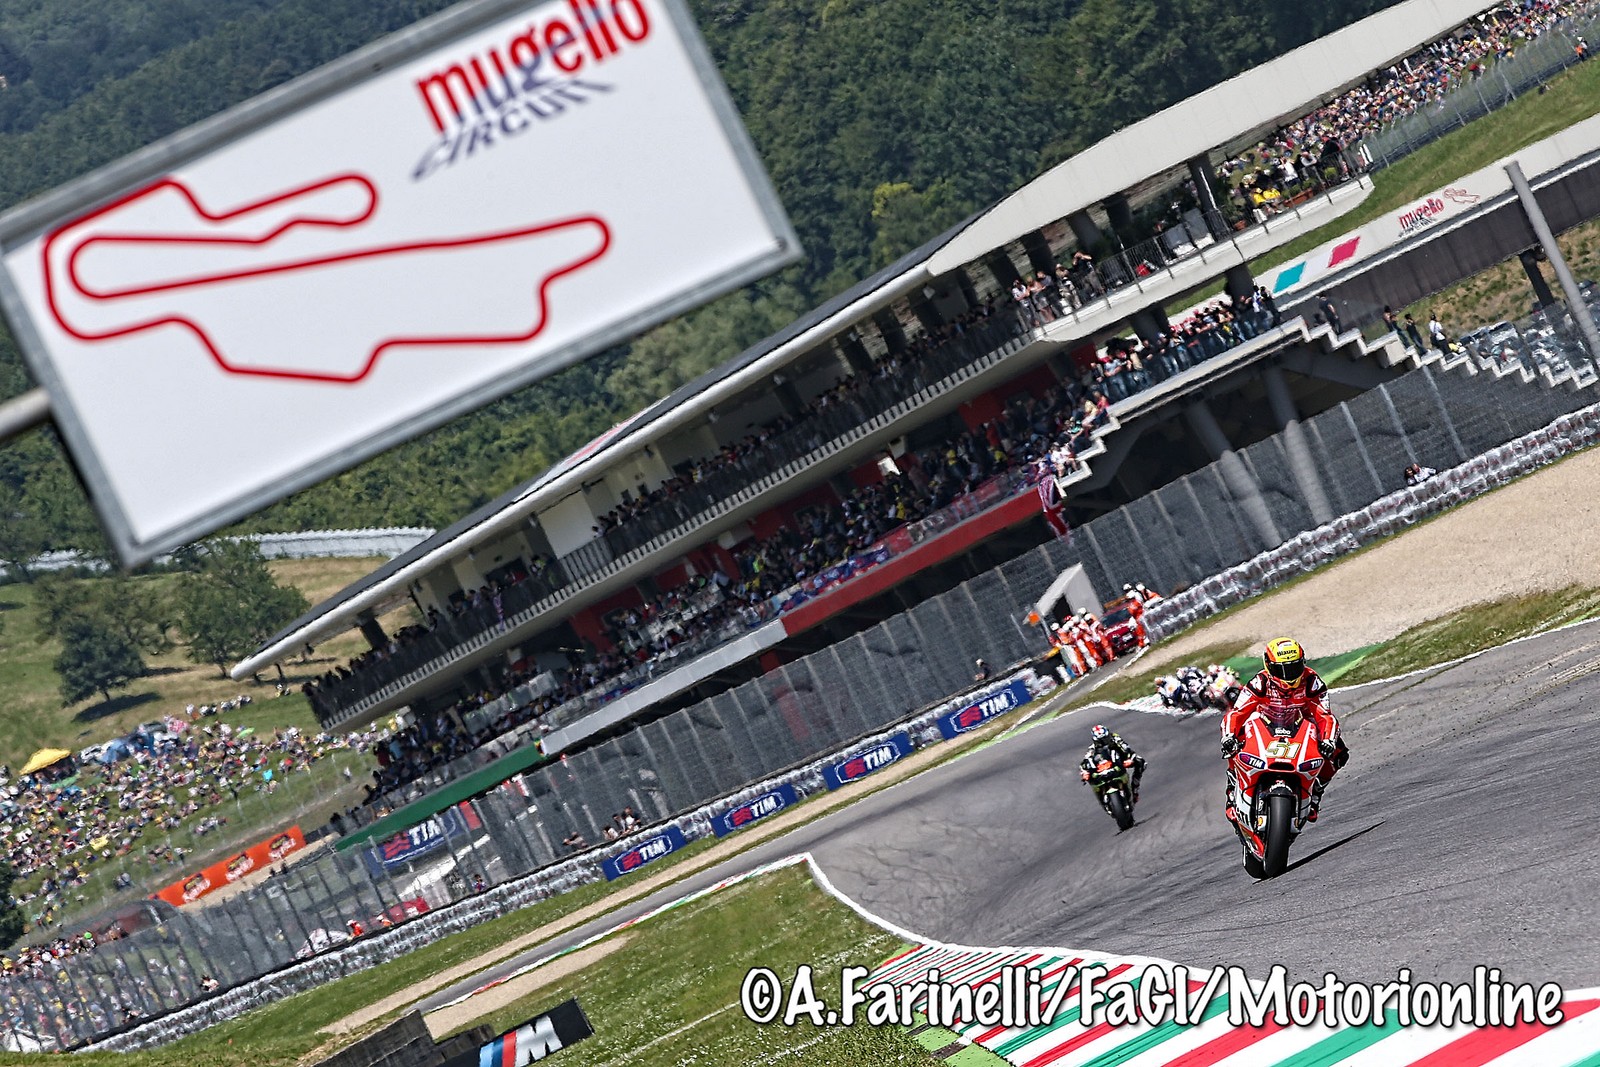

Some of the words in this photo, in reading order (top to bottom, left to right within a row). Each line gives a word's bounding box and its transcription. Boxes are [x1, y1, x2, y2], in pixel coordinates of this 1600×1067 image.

[415, 0, 652, 133] mugello
[1399, 198, 1445, 230] mugello
[979, 693, 1009, 717] TIM
[863, 746, 892, 770] TIM
[1266, 740, 1301, 759] 51
[1249, 757, 1264, 769] TIM
[750, 795, 777, 817] TIM
[639, 838, 667, 860] TIM
